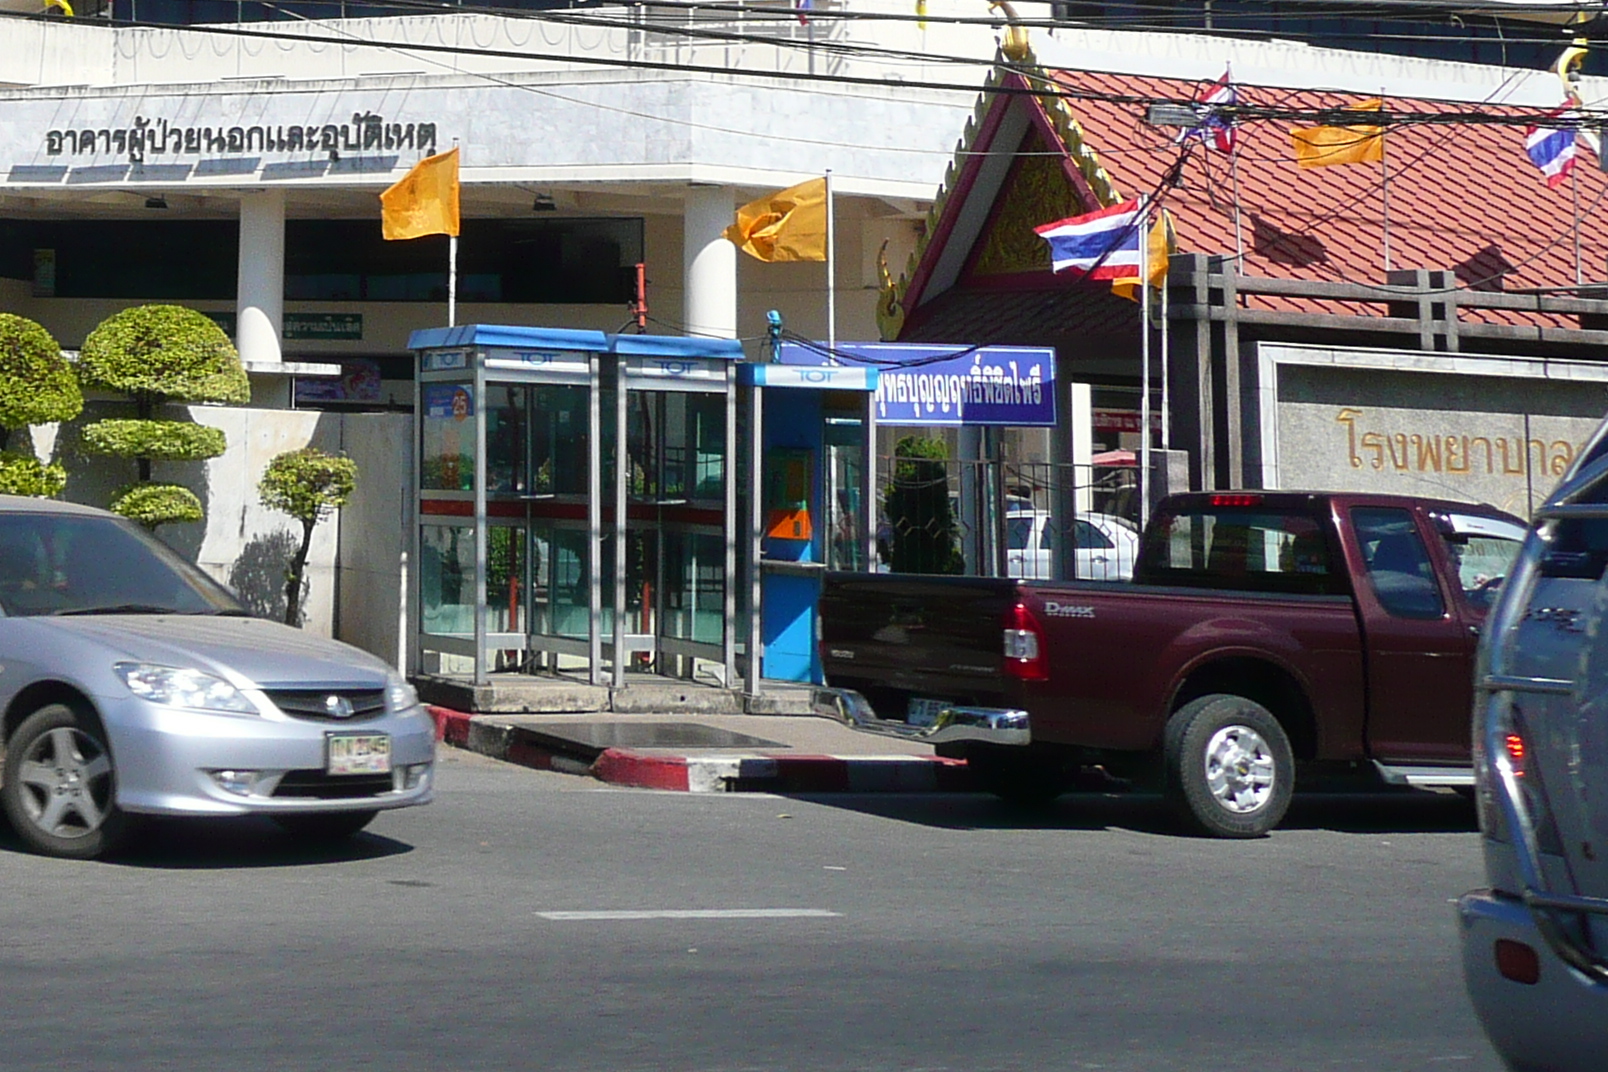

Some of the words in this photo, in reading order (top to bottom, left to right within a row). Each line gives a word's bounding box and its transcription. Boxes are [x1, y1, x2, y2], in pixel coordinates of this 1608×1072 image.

[45, 111, 437, 163] อาคารผู้ป่วยนอกและอุบัติเหตุ
[513, 351, 561, 366] TOT
[652, 360, 699, 375] TOT
[792, 369, 839, 383] TOT
